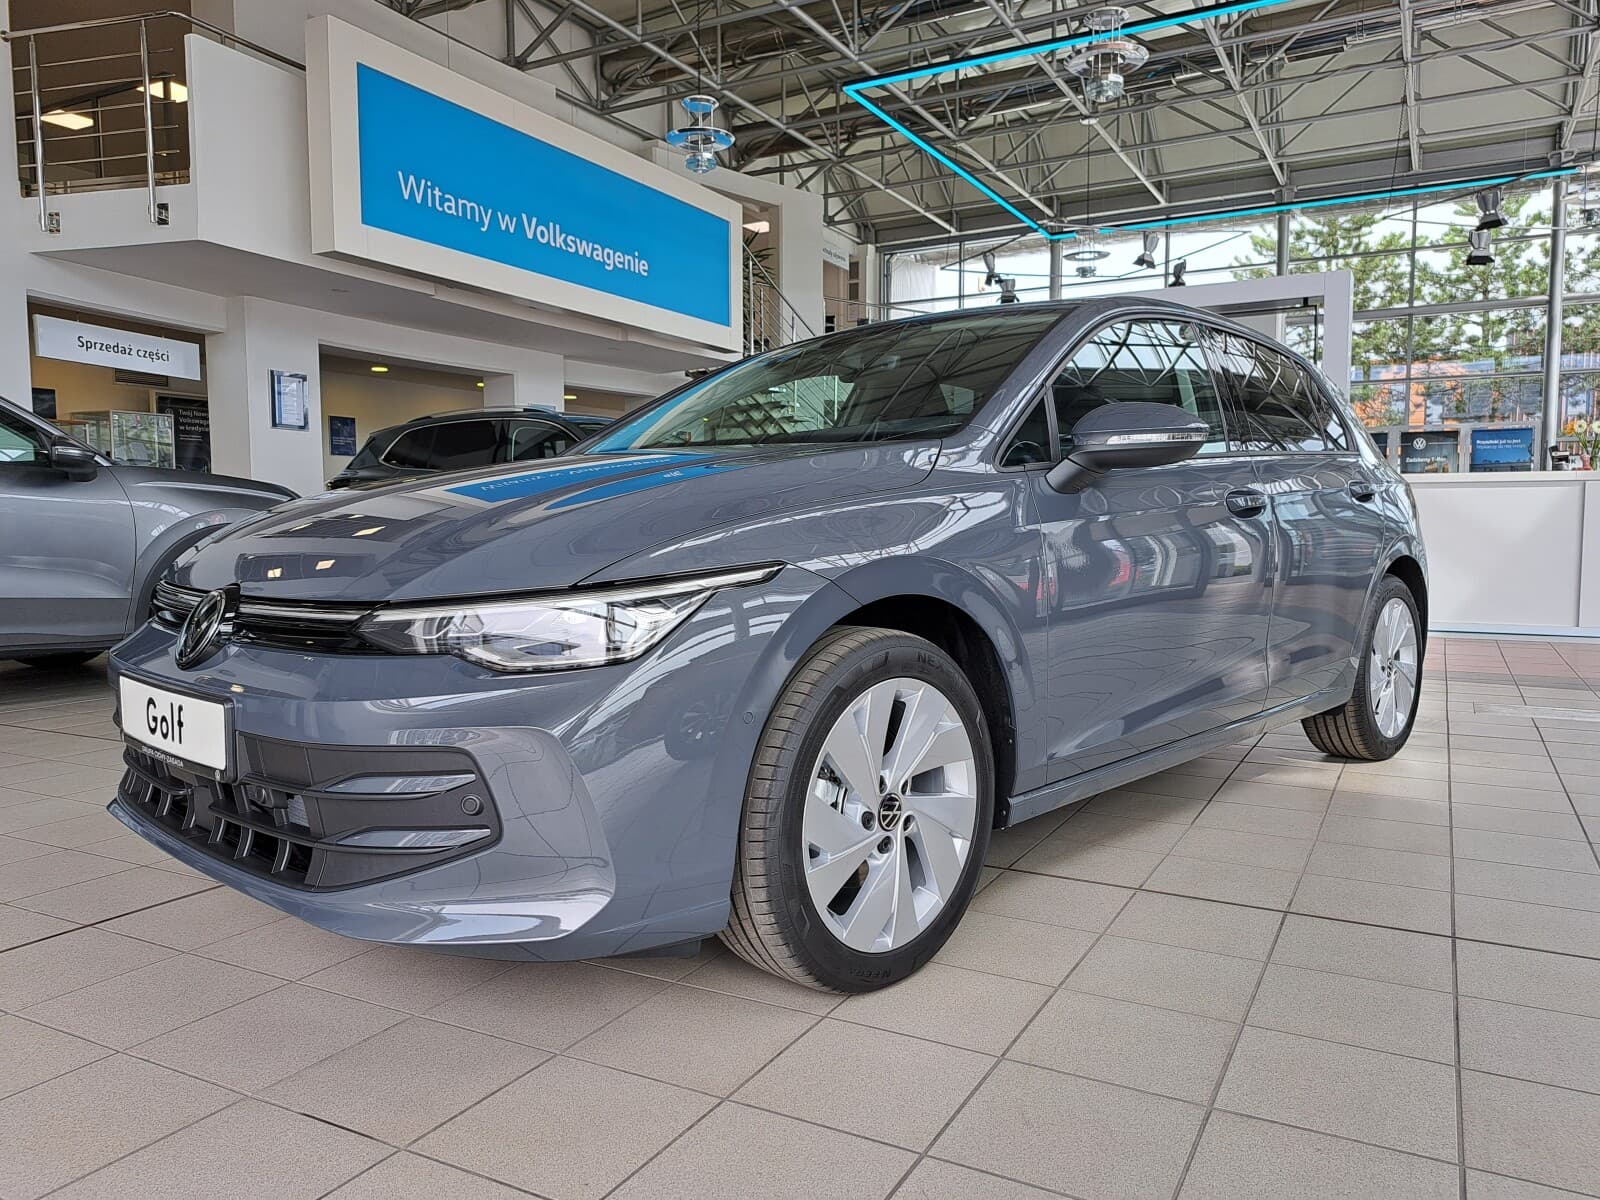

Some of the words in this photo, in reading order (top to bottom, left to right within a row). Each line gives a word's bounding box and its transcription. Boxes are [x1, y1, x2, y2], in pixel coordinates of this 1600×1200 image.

[398, 170, 492, 232] Witamy
[498, 211, 517, 234] w
[522, 213, 649, 277] Volkswagenie
[77, 335, 133, 356] Sprzedaż
[136, 348, 170, 363] części
[146, 697, 184, 745] Golf
